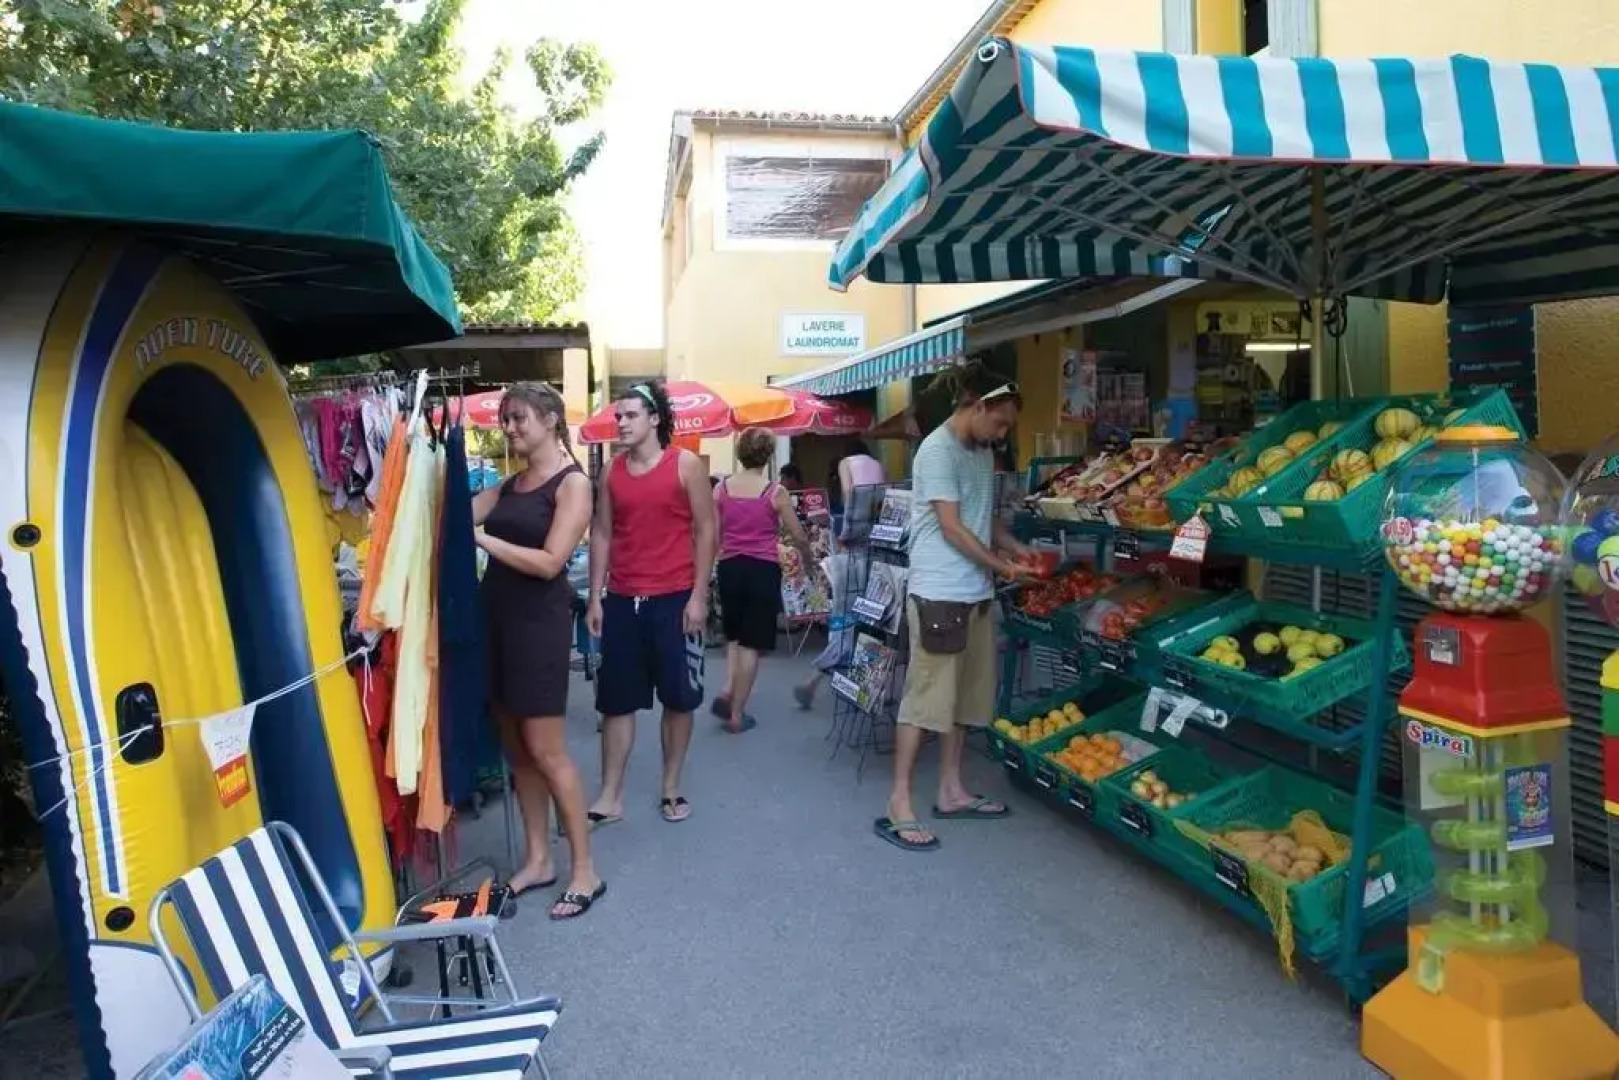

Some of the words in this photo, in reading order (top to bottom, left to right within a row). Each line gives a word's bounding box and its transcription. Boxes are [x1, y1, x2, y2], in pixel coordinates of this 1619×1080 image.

[802, 320, 845, 331] LAVERIE
[787, 336, 860, 347] LAUNDROMAT
[673, 416, 703, 430] IKO
[1404, 721, 1473, 756] Spiral
